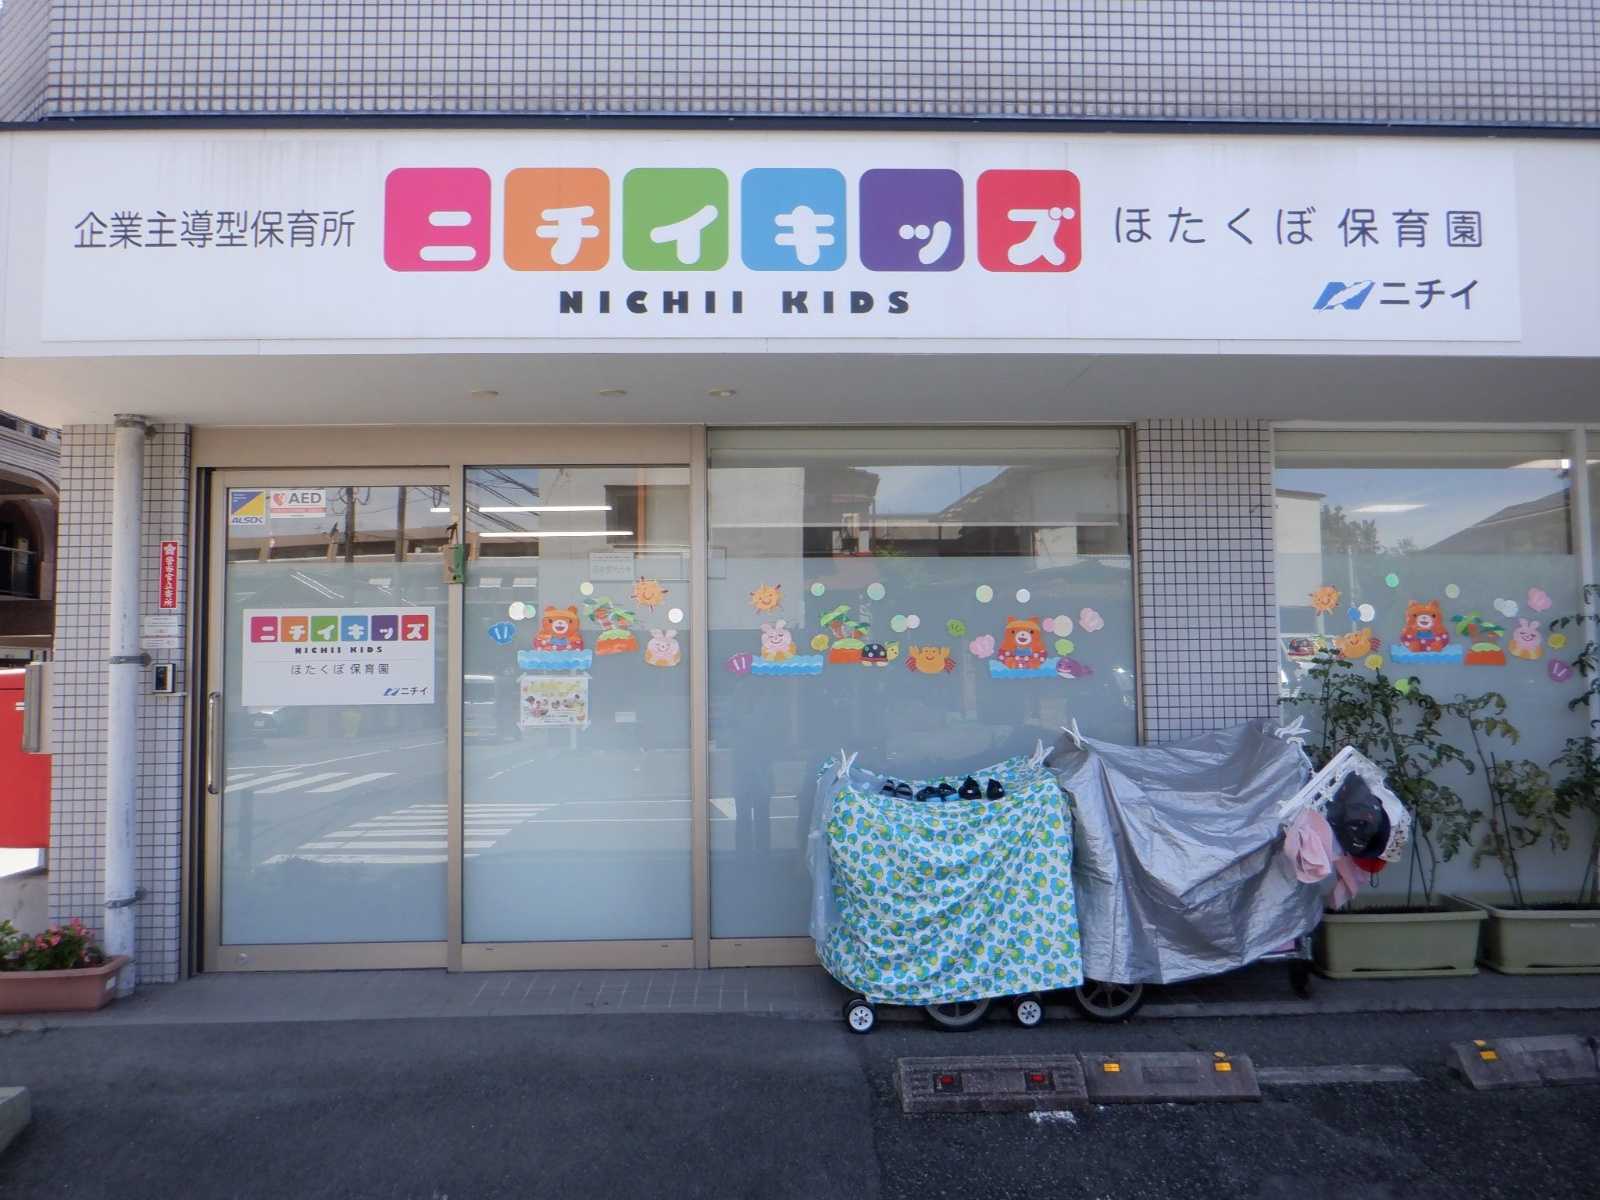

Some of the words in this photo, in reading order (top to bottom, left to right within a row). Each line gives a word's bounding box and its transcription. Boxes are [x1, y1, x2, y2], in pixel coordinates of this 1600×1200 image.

[75, 209, 355, 249] 企業主導型保育所
[418, 203, 1076, 268] ニチイキッズ
[559, 290, 744, 314] NICHII
[782, 290, 910, 314] KIDS
[1380, 279, 1479, 310] ニチイ
[288, 492, 322, 504] AED
[260, 623, 425, 641] ニチイキッズ
[350, 646, 384, 654] KIDS
[400, 687, 429, 696] ニチイ
